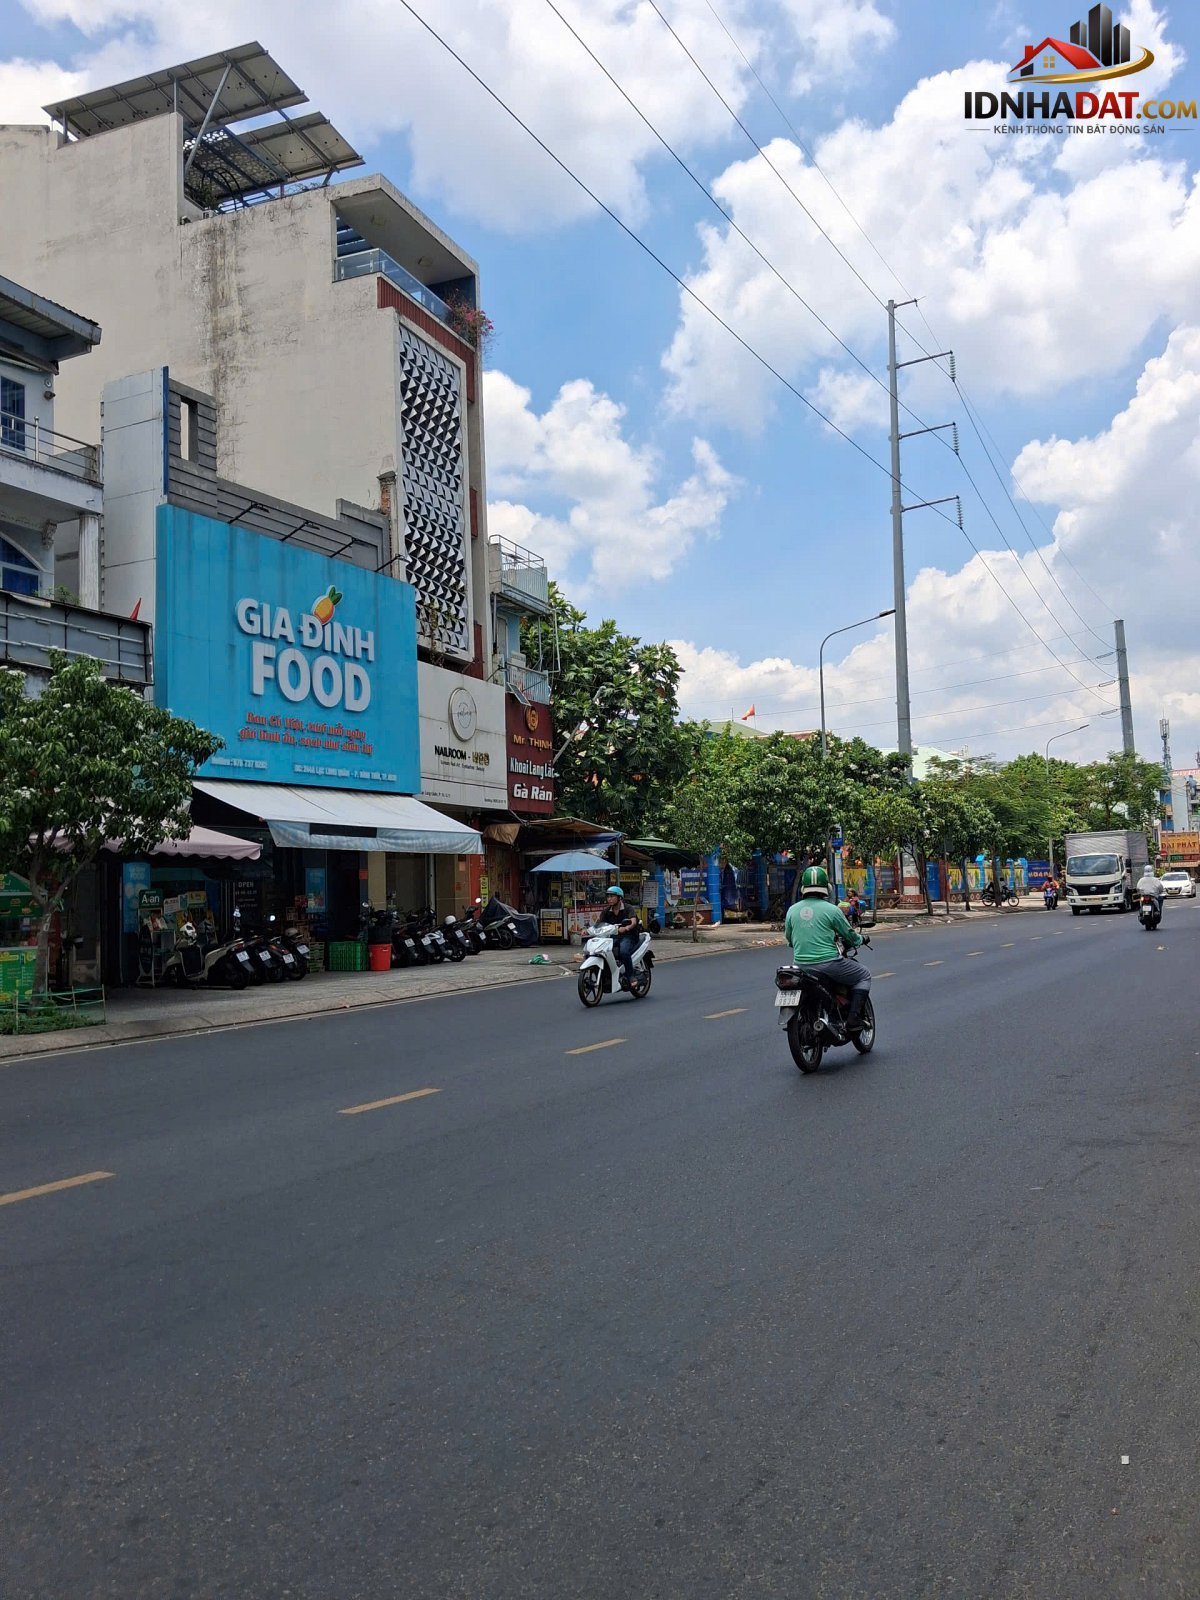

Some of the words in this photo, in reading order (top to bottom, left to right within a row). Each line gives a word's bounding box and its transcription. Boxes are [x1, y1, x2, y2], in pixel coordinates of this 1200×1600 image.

[235, 598, 295, 643] GIA
[252, 641, 371, 712] FOOD
[435, 745, 467, 760] NAILROOM
[509, 757, 528, 775] Khoai
[528, 760, 544, 780] Lang
[513, 783, 529, 799] Gà
[531, 785, 553, 801] Rán
